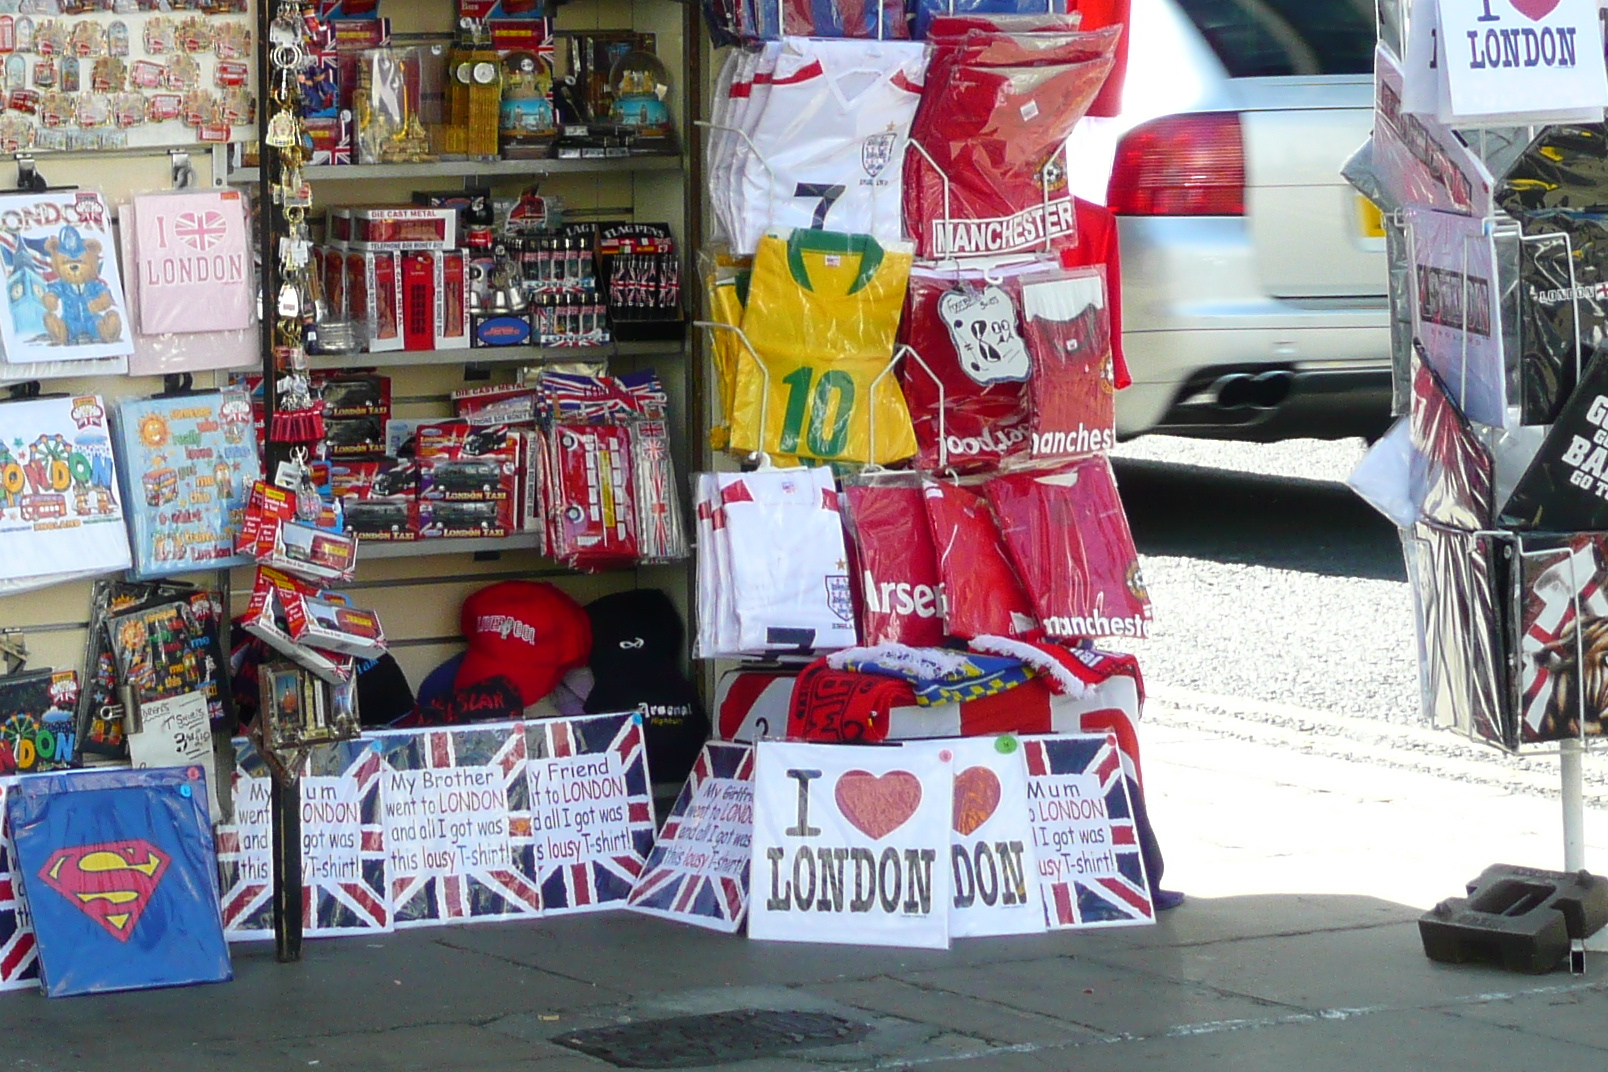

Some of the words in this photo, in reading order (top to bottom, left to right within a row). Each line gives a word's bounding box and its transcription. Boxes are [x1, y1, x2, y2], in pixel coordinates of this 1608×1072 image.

[461, 2, 480, 11] Bus
[1466, 26, 1577, 70] LONDON
[371, 210, 385, 218] DIE
[387, 210, 408, 218] CAST
[410, 209, 437, 217] METAL
[793, 182, 847, 230] 7
[156, 216, 168, 249] I
[603, 224, 634, 239] FLAG
[634, 225, 666, 238] PENS
[935, 200, 1073, 255] MANCHESTER
[146, 253, 243, 286] LONDON
[472, 386, 493, 395] CAST
[497, 382, 527, 391] METAL
[333, 405, 366, 417] LONDON
[368, 405, 387, 416] TAXI
[780, 367, 856, 458] 10
[333, 443, 367, 454] LONDON
[1569, 469, 1594, 490] GO
[445, 490, 482, 501] LONDON
[483, 490, 507, 501] TAXI
[352, 530, 390, 541] LONDON
[391, 530, 415, 541] TAXI
[443, 527, 481, 538] LONDON
[481, 527, 505, 538] TAXI
[190, 543, 232, 561] London
[191, 635, 211, 647] me
[169, 663, 185, 675] me
[638, 702, 693, 719] Arsenal
[389, 772, 417, 798] My
[421, 768, 495, 791] Brother
[546, 760, 610, 784] Friend
[249, 782, 271, 805] My
[544, 785, 561, 806] to
[561, 775, 625, 804] LONDON
[703, 783, 721, 799] My
[785, 768, 824, 837] I
[1026, 780, 1081, 800] Mum
[238, 806, 270, 826] went
[302, 801, 359, 824] ONDON
[384, 793, 419, 818] went
[420, 796, 437, 816] to
[438, 789, 506, 815] LONDON
[712, 802, 721, 820] to
[1038, 798, 1105, 822] LONDON
[390, 818, 418, 842] and
[418, 817, 438, 841] all
[437, 817, 448, 839] I
[450, 815, 475, 844] got
[475, 816, 504, 837] was
[542, 808, 560, 831] all
[560, 807, 573, 829] I
[574, 806, 597, 832] got
[597, 805, 624, 826] was
[243, 828, 269, 851] and
[302, 830, 326, 855] got
[328, 832, 355, 849] was
[546, 836, 582, 869] lousy
[580, 827, 633, 858] T-shirt!
[678, 825, 696, 841] and
[695, 823, 709, 841] all
[707, 824, 720, 844] I
[715, 827, 734, 847] got
[733, 832, 752, 848] was
[1038, 826, 1050, 847] I
[1052, 825, 1075, 853] got
[1078, 827, 1106, 845] was
[240, 852, 269, 879] this
[309, 852, 360, 879] T-shirt!
[390, 845, 418, 873] this
[420, 842, 457, 874] lousy
[456, 836, 512, 866] T-shirt!
[663, 846, 685, 866] this
[683, 847, 709, 874] lousy
[707, 849, 750, 875] T-shirt!
[765, 846, 936, 914] LONDON
[951, 840, 1028, 906] DON
